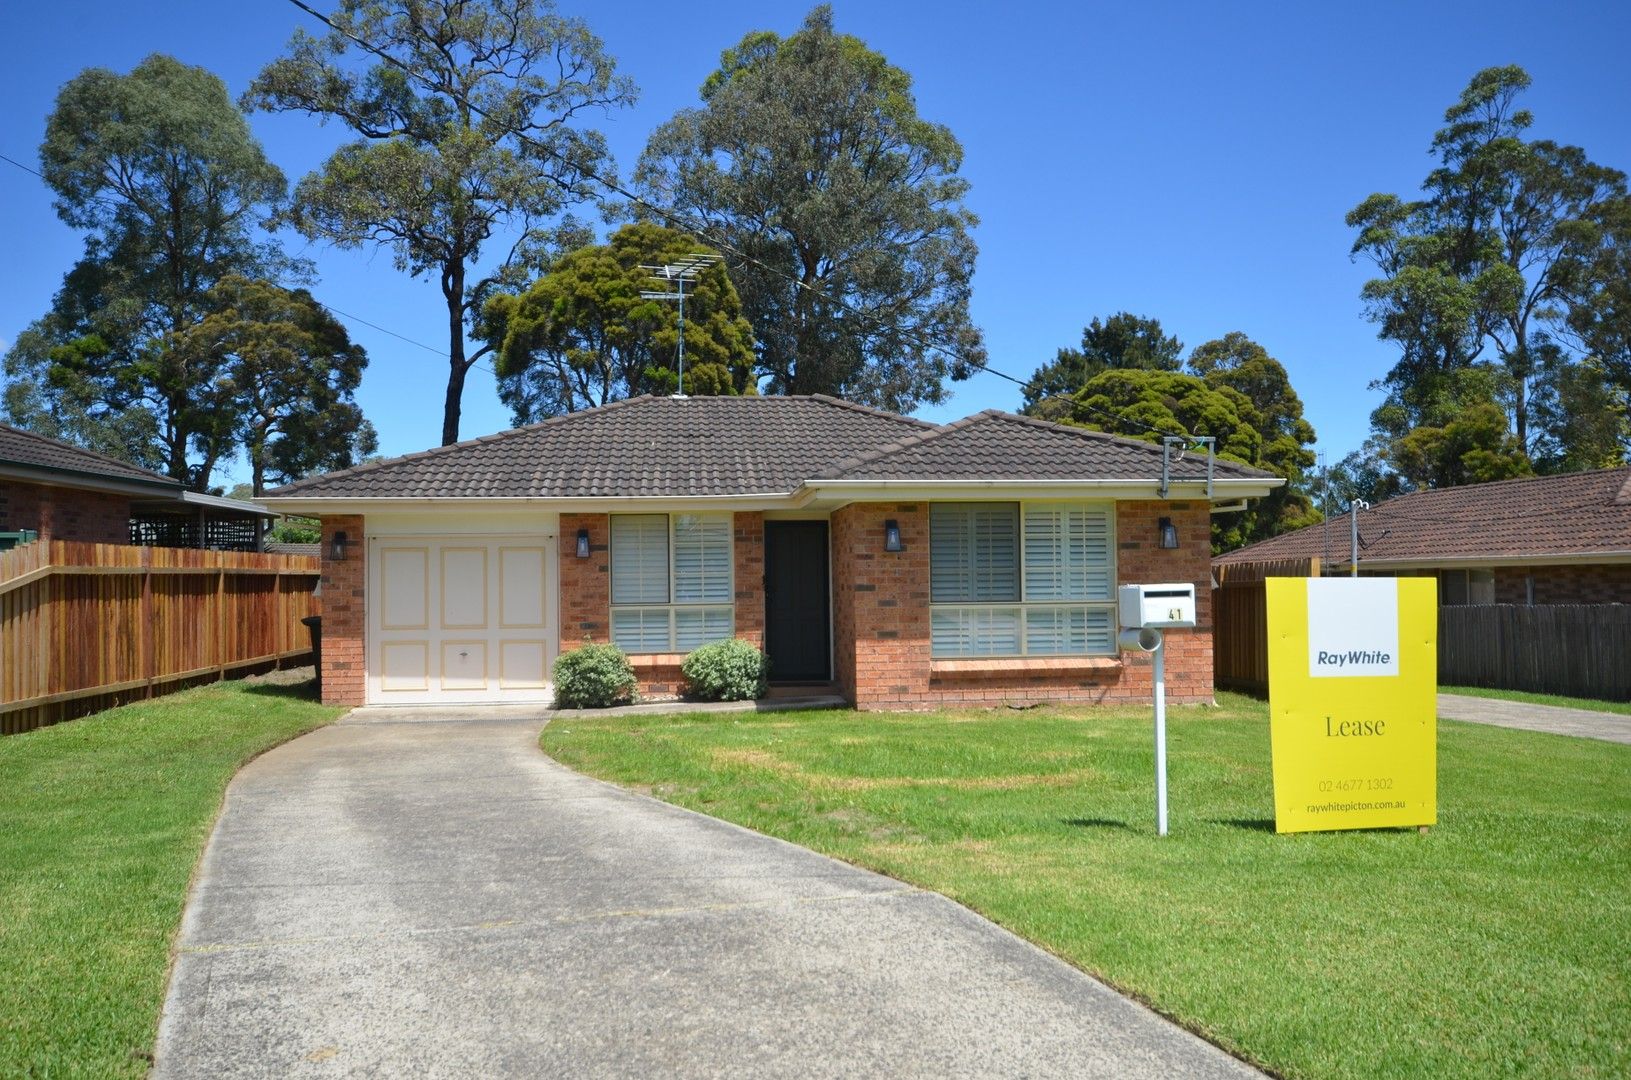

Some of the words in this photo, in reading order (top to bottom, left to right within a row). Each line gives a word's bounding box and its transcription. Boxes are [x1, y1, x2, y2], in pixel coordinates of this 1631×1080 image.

[1168, 608, 1181, 620] 41
[1326, 716, 1386, 737] Lease
[1318, 780, 1333, 792] 02
[1335, 779, 1364, 792] 4677
[1367, 778, 1393, 790] 1302
[1306, 800, 1406, 813] raywhitepicton.com.au
